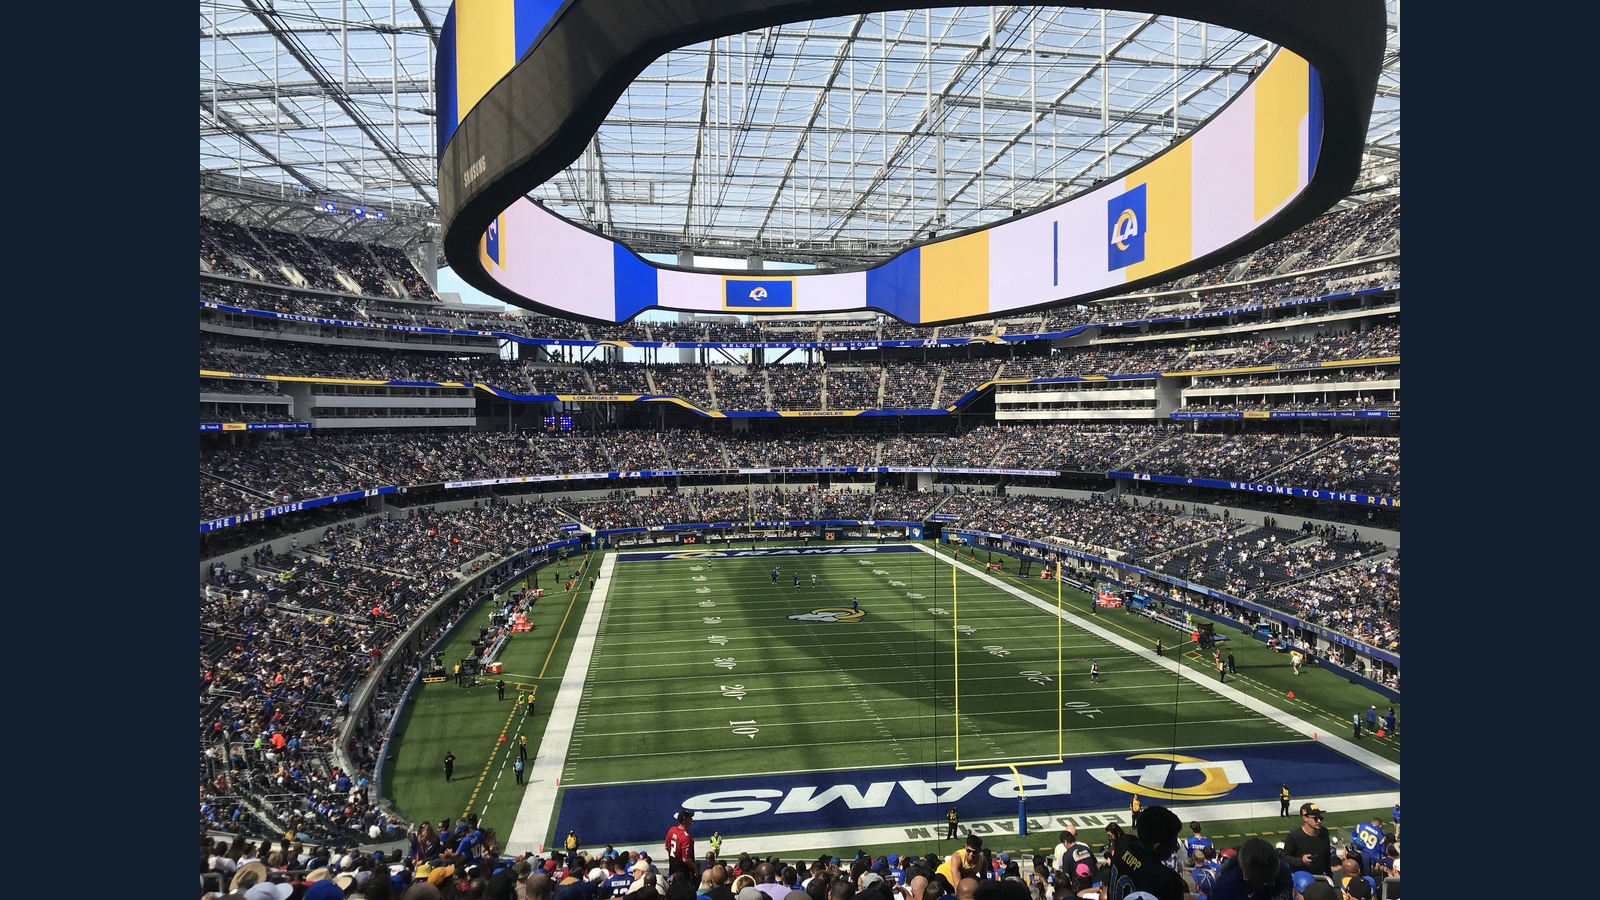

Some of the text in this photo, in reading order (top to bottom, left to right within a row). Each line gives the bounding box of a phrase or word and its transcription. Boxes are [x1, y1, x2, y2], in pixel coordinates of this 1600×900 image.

[463, 155, 486, 188] SAMSUNG
[276, 313, 318, 323] WELCOME
[1180, 311, 1223, 320] WELCOME
[1291, 297, 1322, 305] HOUSE
[1229, 482, 1293, 495] WELCOME
[1302, 489, 1319, 498] TO
[1329, 492, 1357, 502] THE
[208, 502, 303, 531] THE RAMS HOUSE
[733, 547, 878, 557] RAMS
[1064, 549, 1084, 559] HOUSE
[1299, 621, 1371, 654] RAMS HOUSE
[713, 657, 737, 668] 30
[1020, 670, 1053, 683] 20
[720, 684, 747, 697] 20
[1064, 702, 1104, 715] 10
[729, 719, 760, 735] 10
[673, 770, 1071, 820] RAMS
[904, 813, 1127, 840] END RACISM
[1360, 830, 1378, 850] 99
[1121, 850, 1142, 871] KUPP
